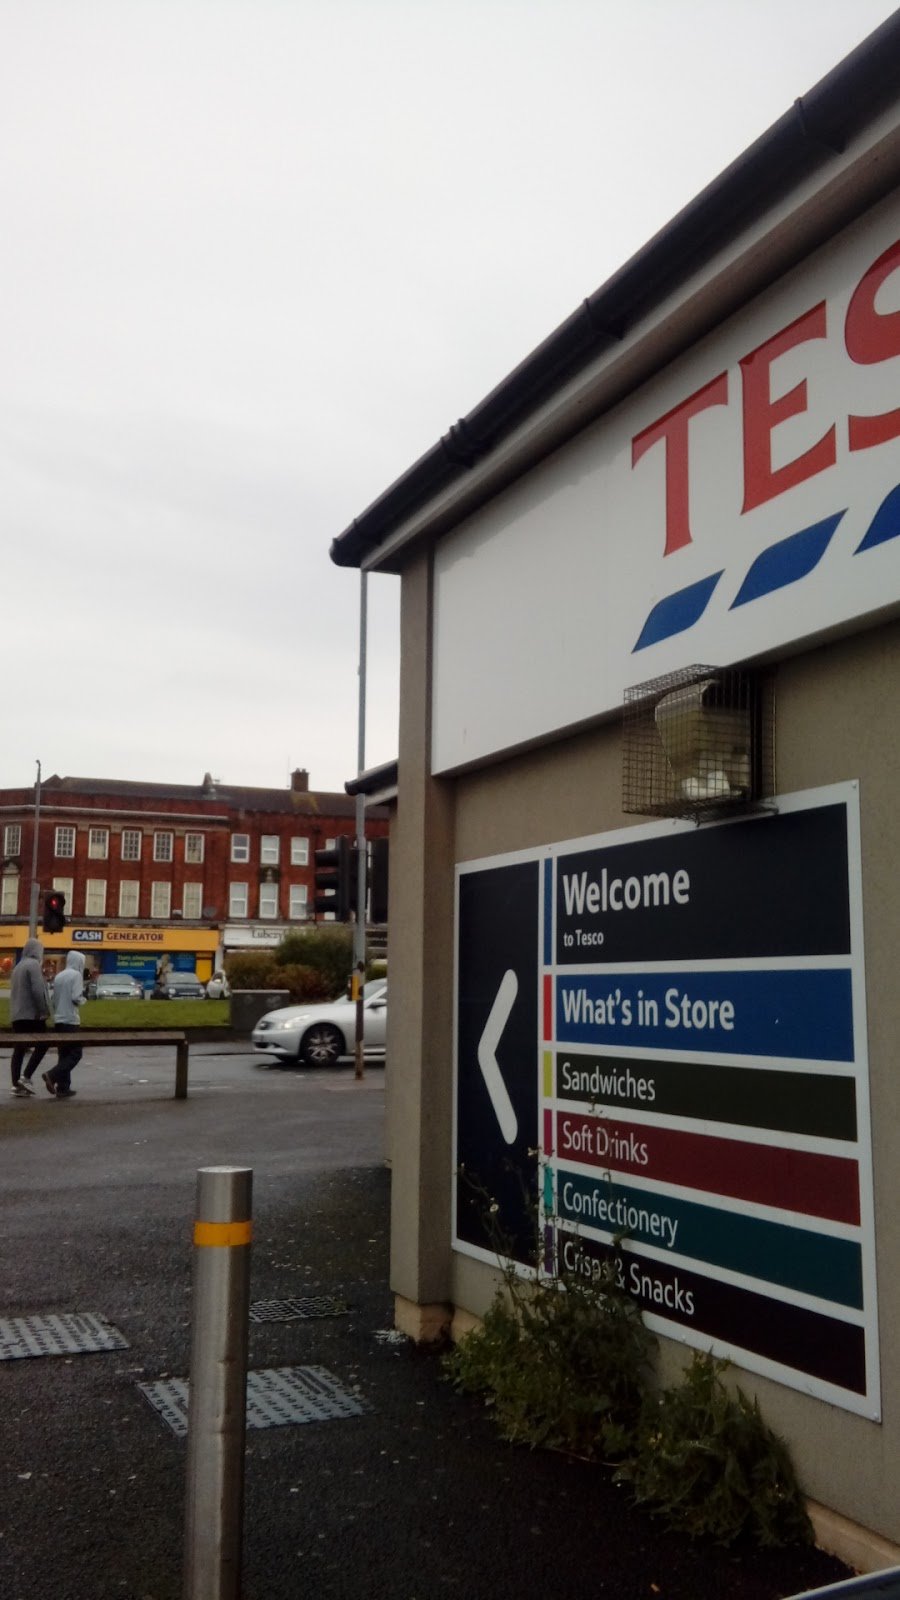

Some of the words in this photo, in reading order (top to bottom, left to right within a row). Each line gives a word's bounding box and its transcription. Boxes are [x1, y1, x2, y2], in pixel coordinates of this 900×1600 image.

[562, 868, 691, 917] Welcome
[74, 930, 102, 941] CASH
[107, 931, 164, 942] GENERATOR
[563, 932, 574, 948] to
[576, 929, 604, 948] Tesco
[562, 988, 632, 1027] What's
[637, 988, 659, 1028] in
[664, 987, 736, 1032] Store
[562, 1061, 656, 1103] Sandwiches
[562, 1120, 594, 1155] Soft
[596, 1126, 649, 1166] Drinks
[562, 1181, 679, 1249] Confectionery
[563, 1240, 609, 1283] Crisps
[614, 1257, 626, 1290] &
[629, 1262, 696, 1316] Snacks
